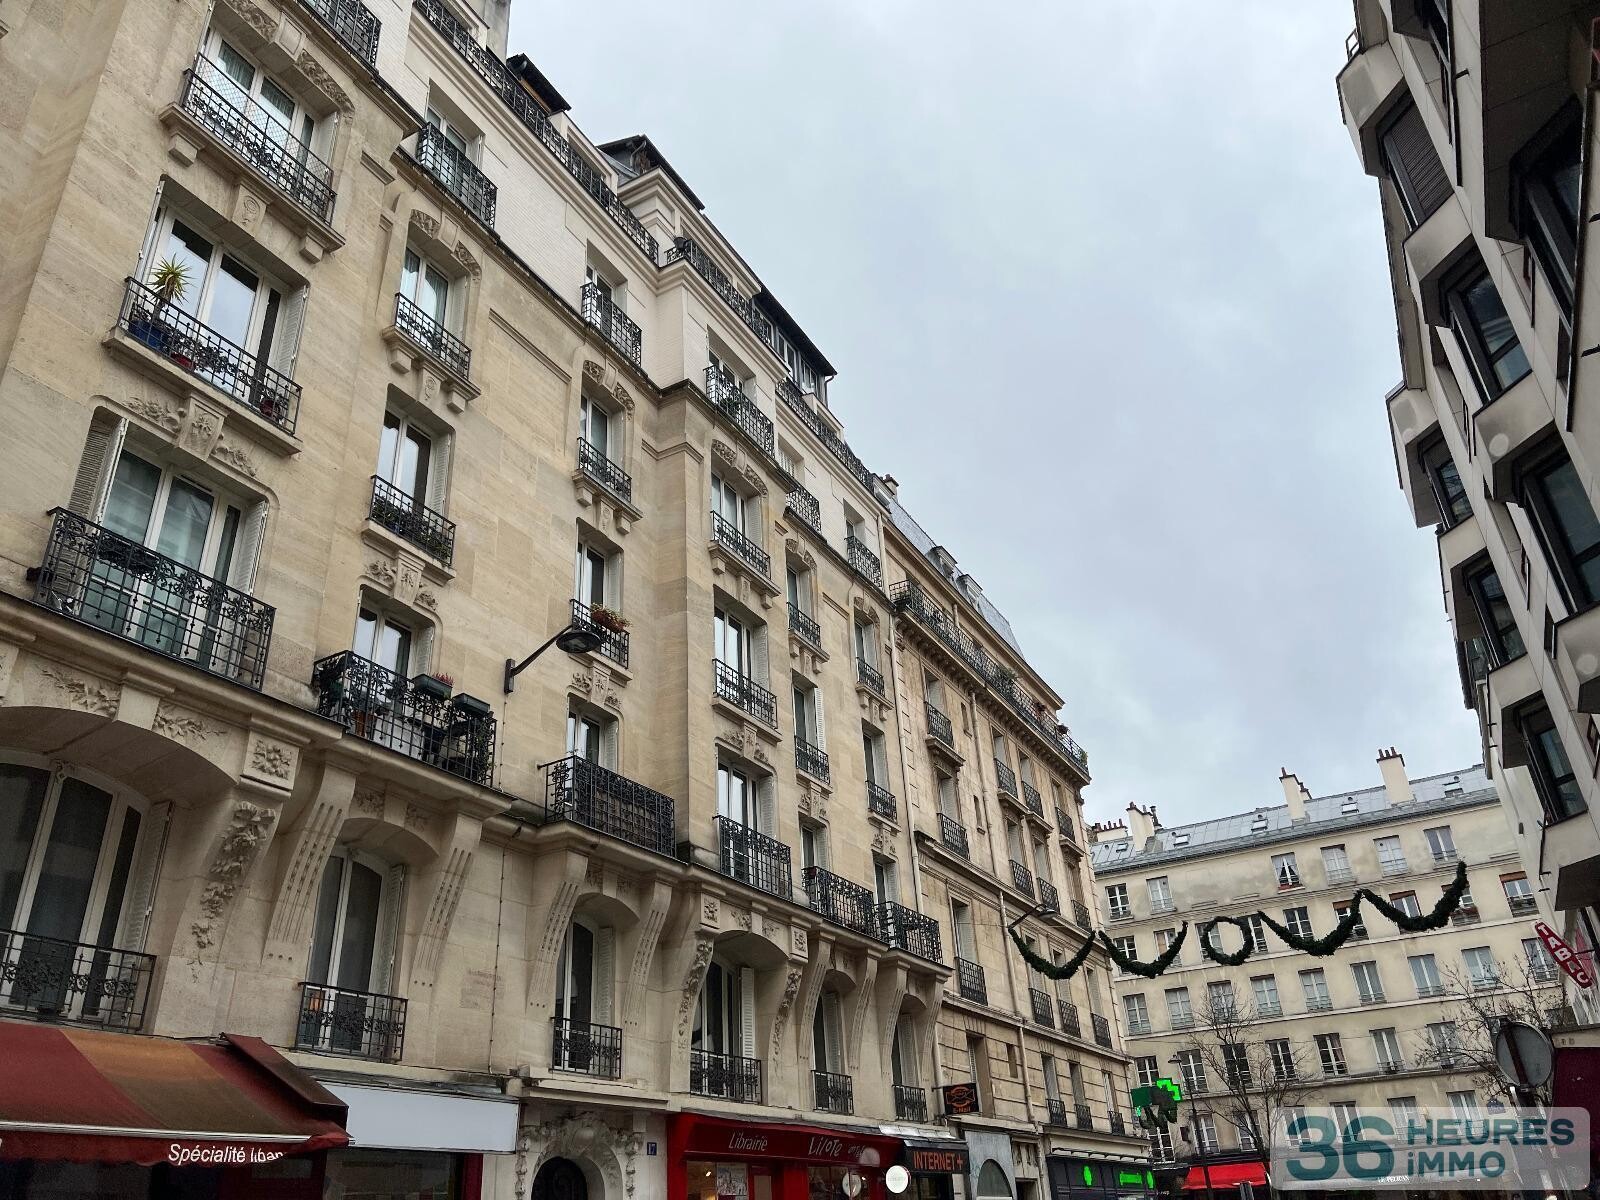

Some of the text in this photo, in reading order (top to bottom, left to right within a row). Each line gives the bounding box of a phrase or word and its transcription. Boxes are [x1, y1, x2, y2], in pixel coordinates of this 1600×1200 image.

[1537, 924, 1589, 984] TABAC
[728, 1131, 768, 1152] Librairie
[168, 1143, 246, 1166] Spécialité
[913, 1151, 956, 1171] INTERNET
